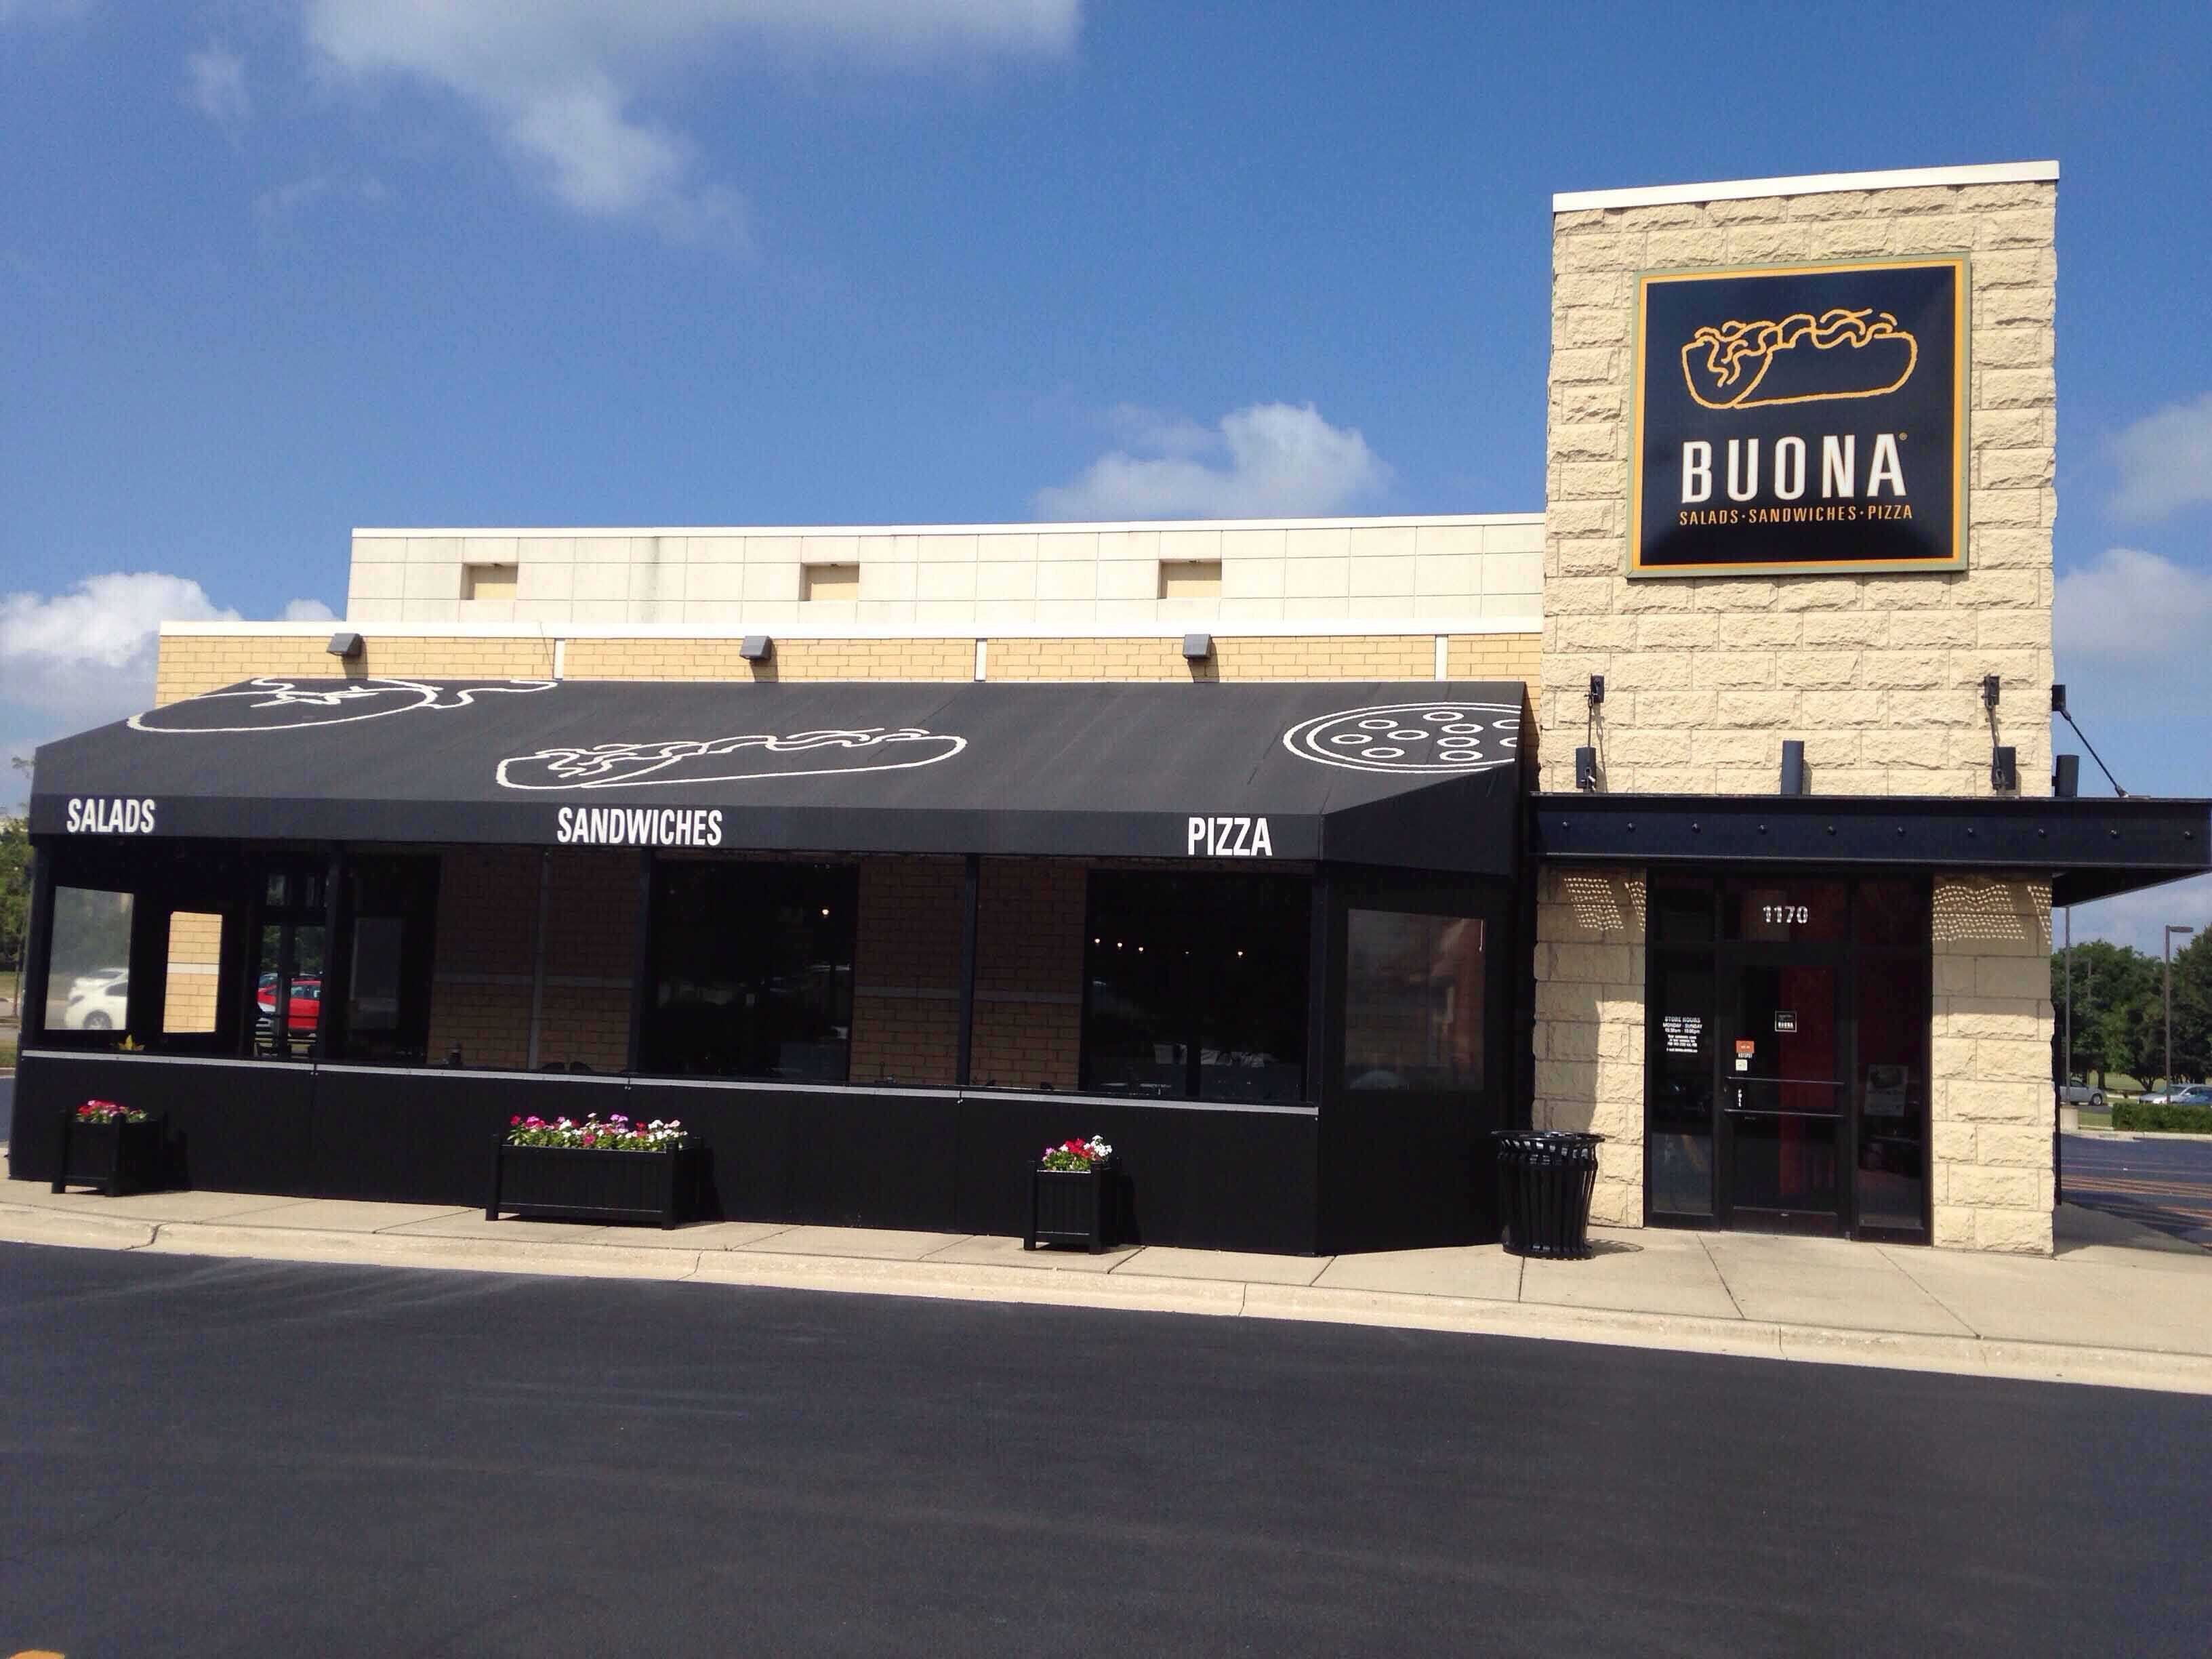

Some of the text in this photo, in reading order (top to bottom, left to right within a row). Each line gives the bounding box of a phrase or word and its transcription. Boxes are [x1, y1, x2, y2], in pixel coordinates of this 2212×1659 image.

[1681, 433, 1906, 504] BUONA
[1679, 504, 1913, 526] SALADS SANDWICHES PIZZA
[66, 798, 155, 833] SALADS
[556, 806, 723, 846] SANDWICHES
[1187, 817, 1273, 856] PIZZA
[1763, 905, 1808, 924] 1170
